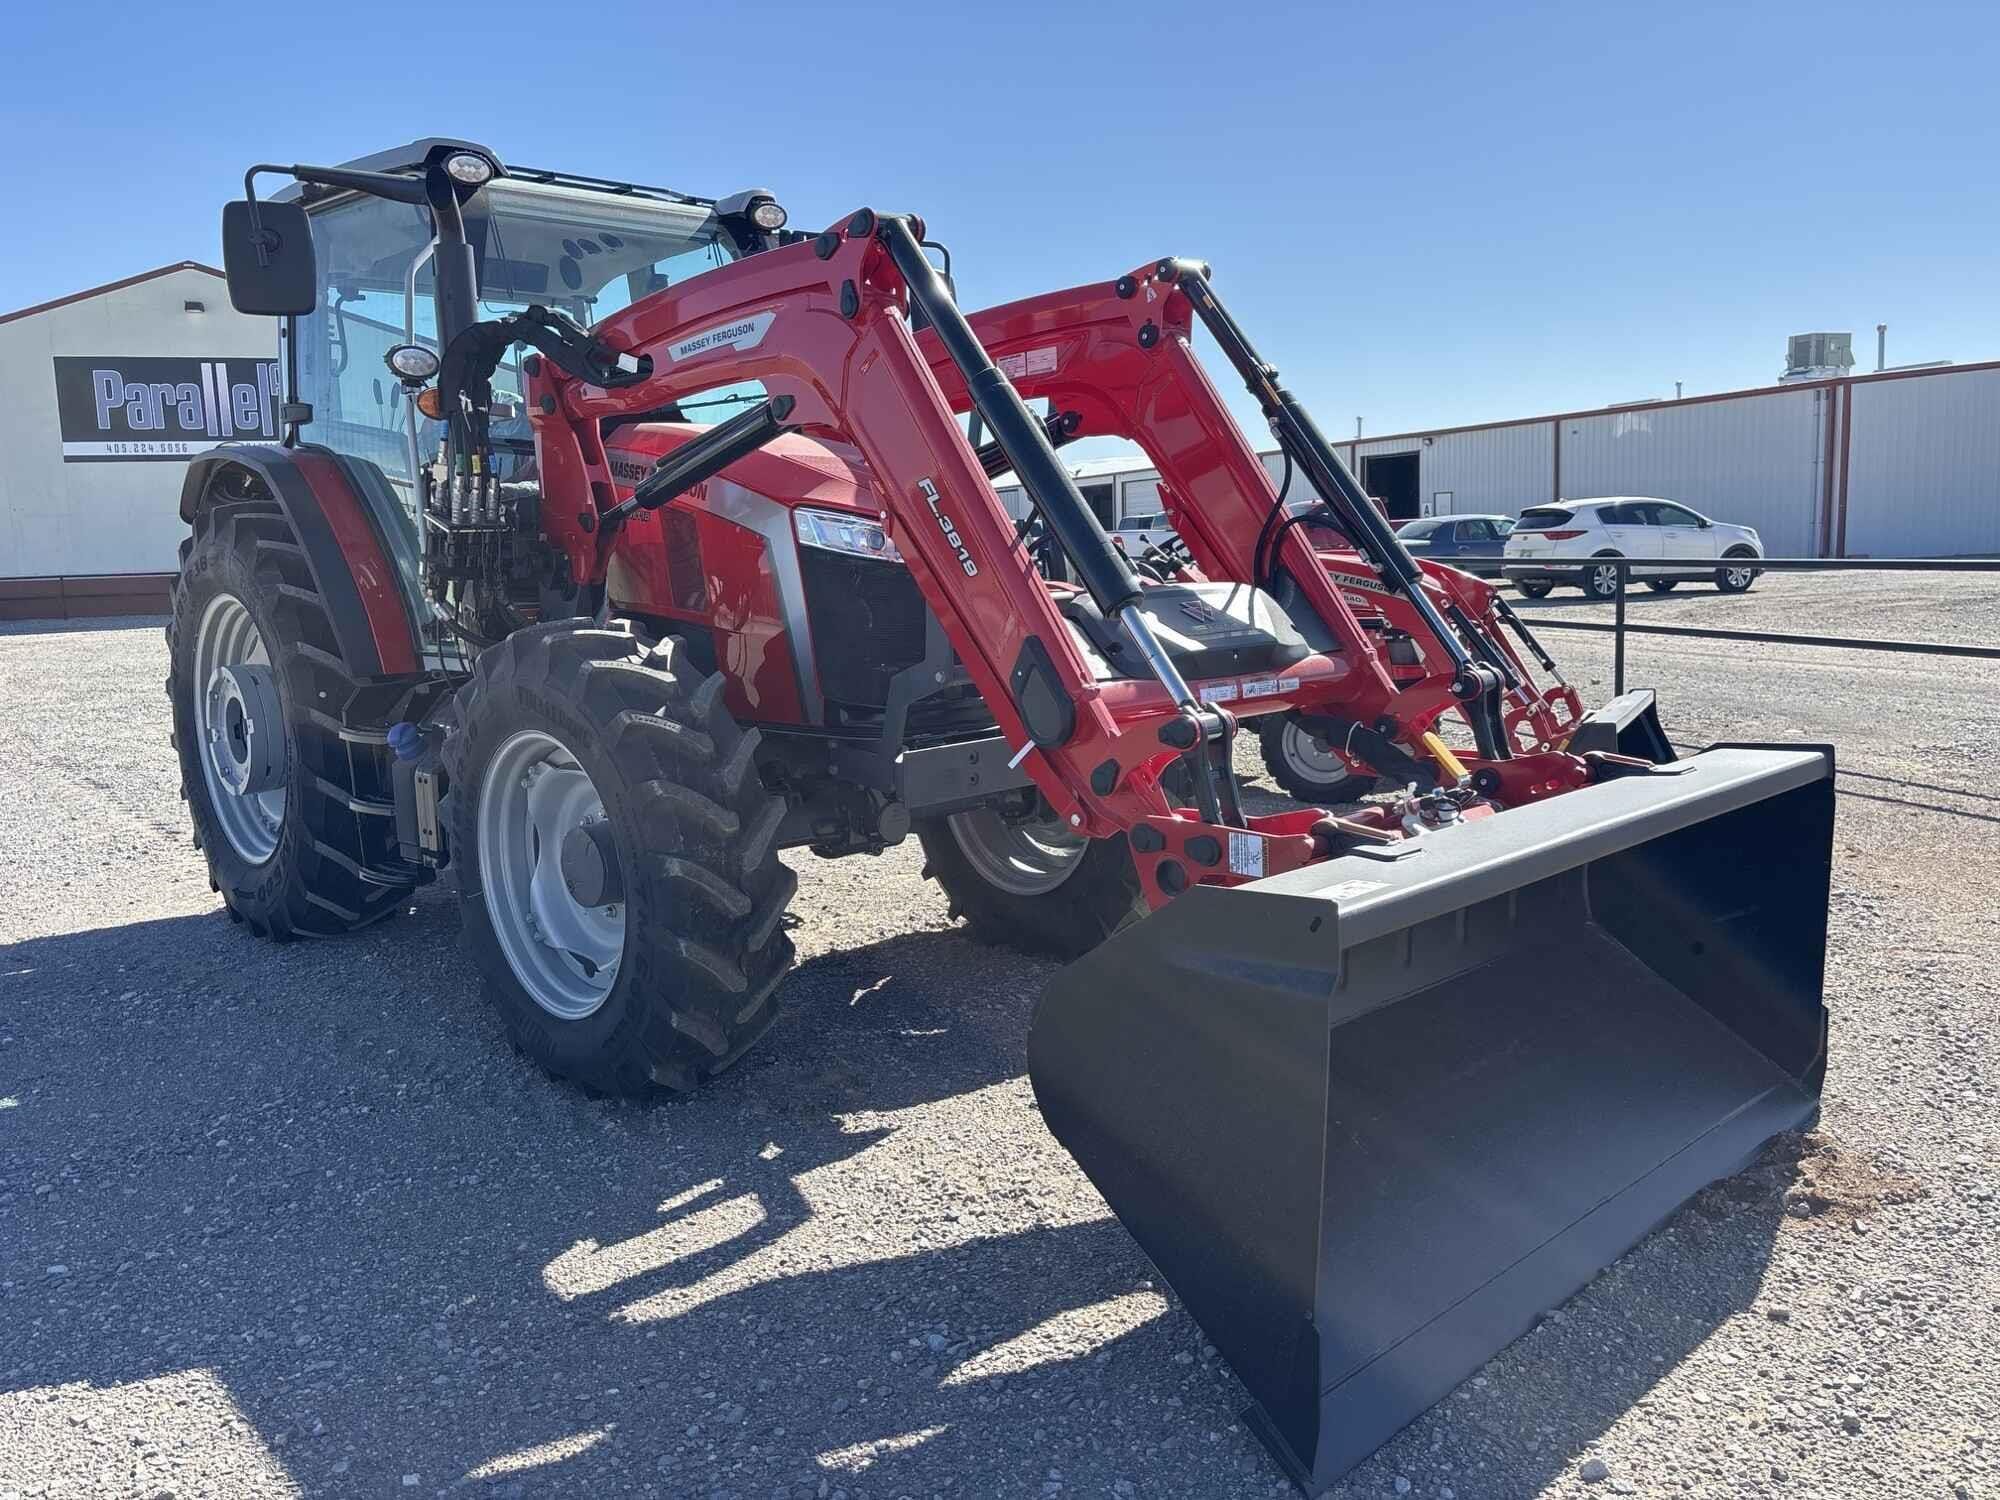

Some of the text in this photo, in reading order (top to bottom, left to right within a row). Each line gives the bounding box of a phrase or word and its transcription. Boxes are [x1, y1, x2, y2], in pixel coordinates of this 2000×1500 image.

[680, 322, 755, 355] MASSEY FERGUSON
[610, 460, 648, 481] MASSEY
[917, 477, 978, 577] FL.3819
[1343, 574, 1387, 592] FERGUS
